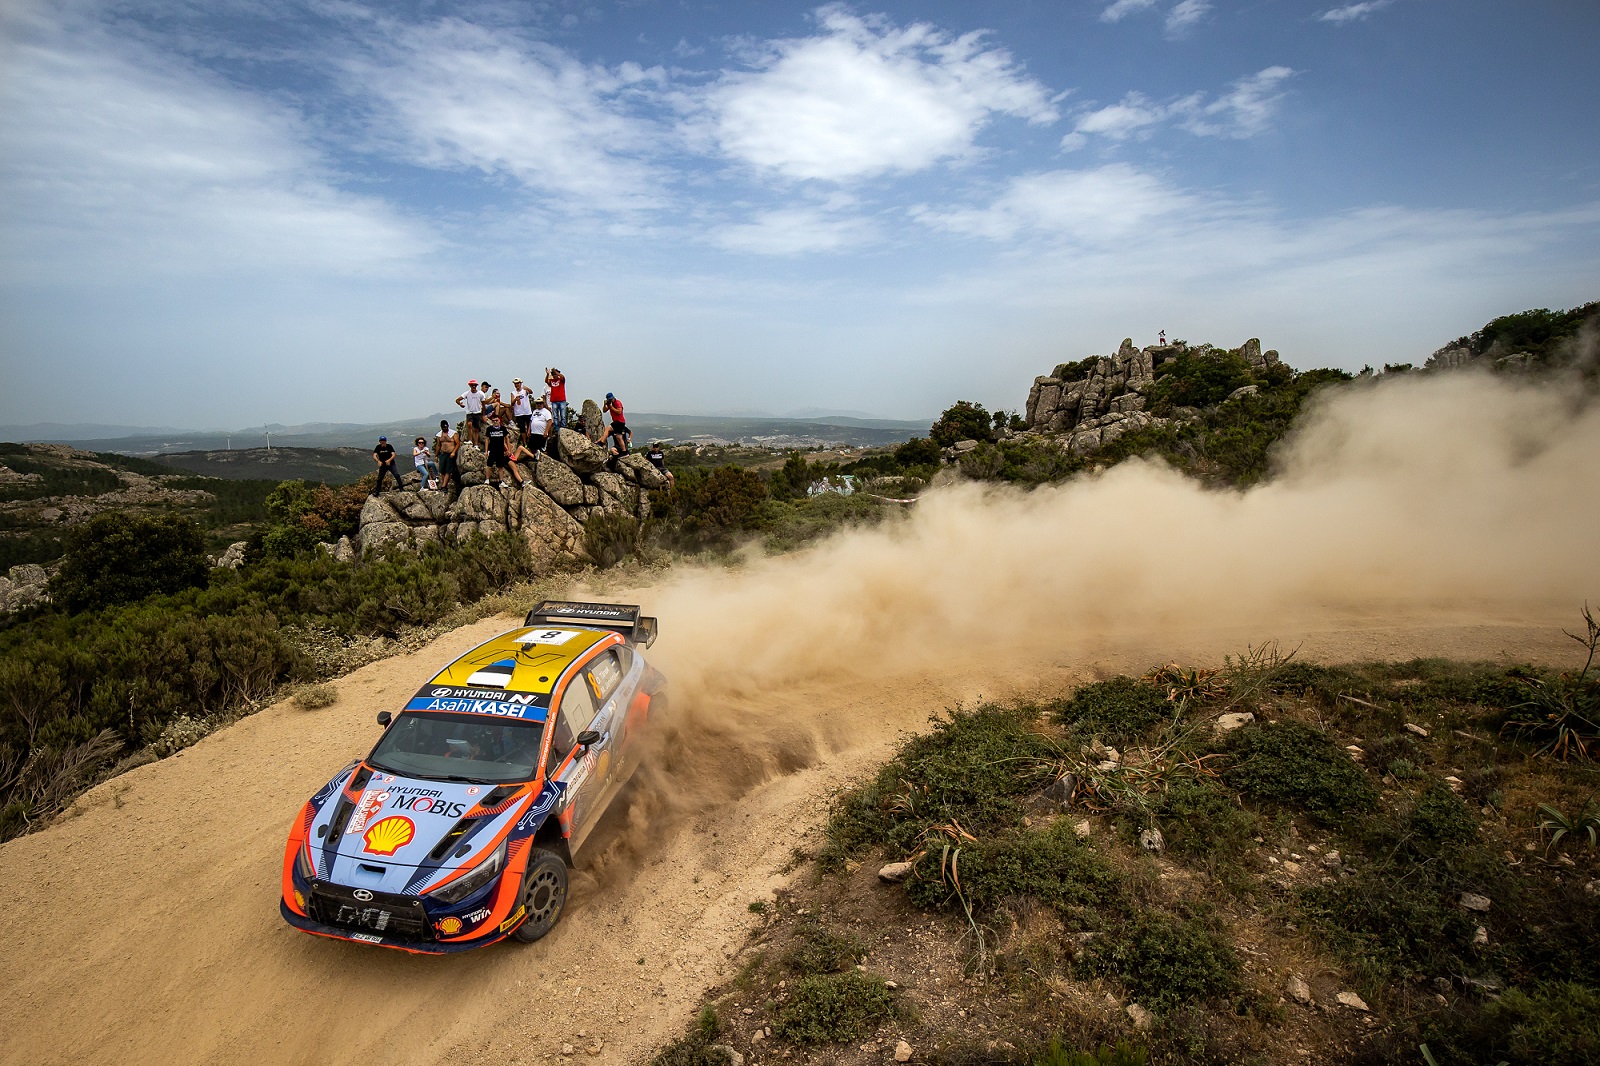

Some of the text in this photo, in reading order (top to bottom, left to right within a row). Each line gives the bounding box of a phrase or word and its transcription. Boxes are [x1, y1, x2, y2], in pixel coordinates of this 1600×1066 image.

[576, 608, 621, 616] HYUNDAI
[540, 630, 562, 639] 8
[587, 671, 602, 699] 8
[453, 689, 507, 700] HYUNDAI
[386, 785, 443, 797] HYUNDAI
[391, 795, 466, 818] MOBIS
[470, 908, 492, 923] WIA
